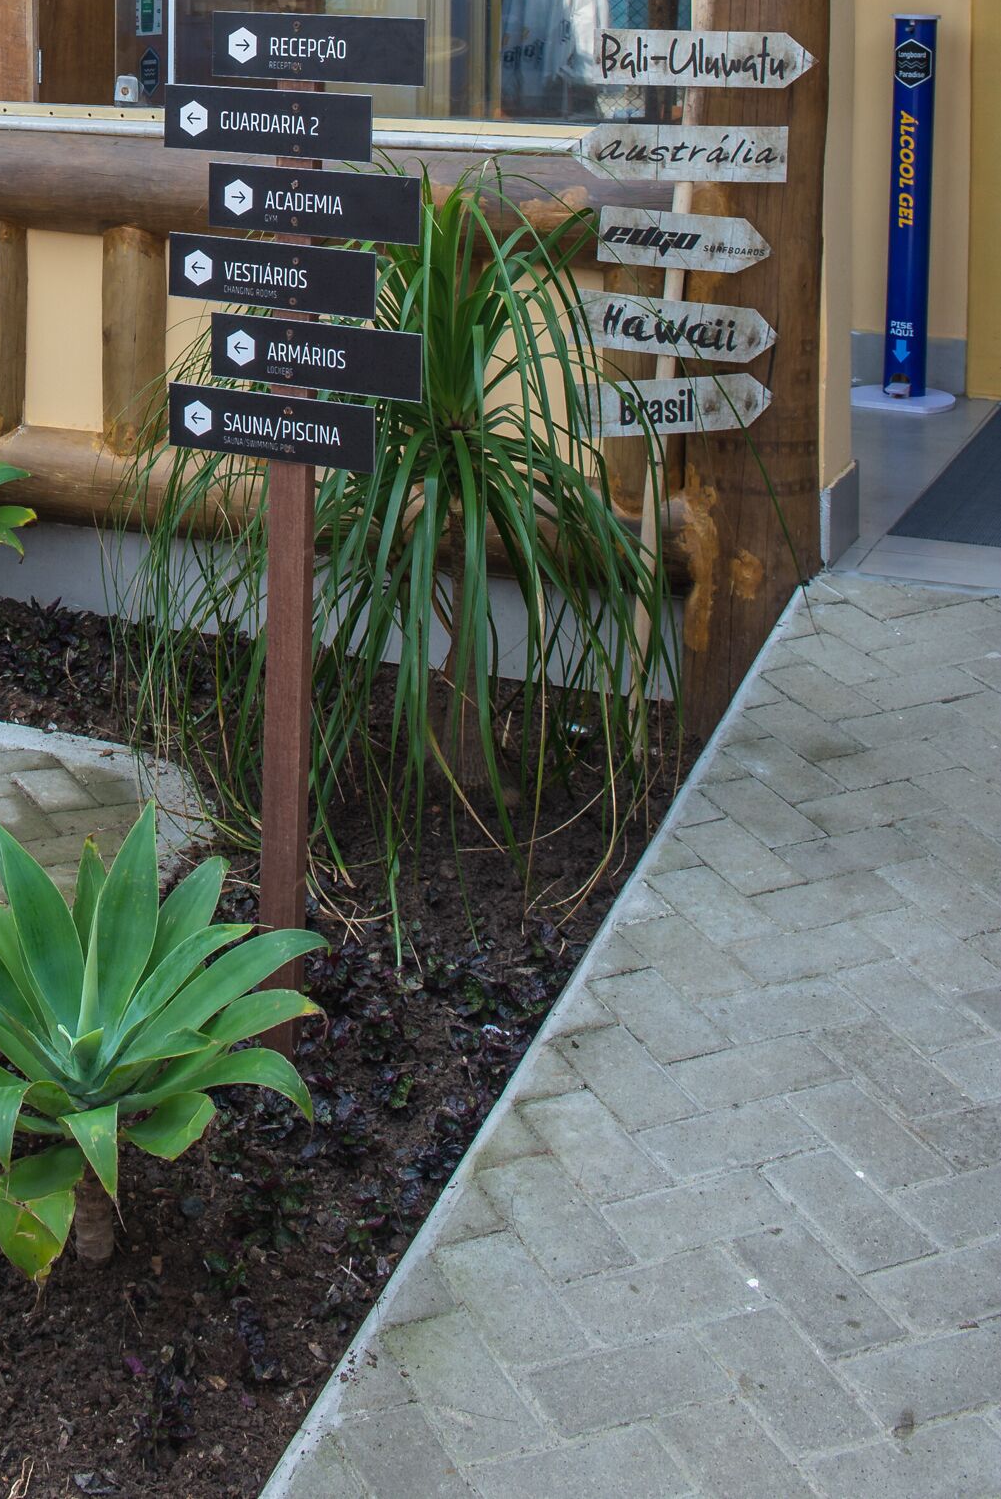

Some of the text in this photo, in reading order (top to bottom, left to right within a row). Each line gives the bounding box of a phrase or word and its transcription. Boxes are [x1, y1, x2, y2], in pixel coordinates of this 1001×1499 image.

[269, 36, 347, 63] RECEPÇÃO
[601, 33, 785, 84] Bali-Uluwatu
[898, 51, 927, 59] Longboard
[269, 61, 302, 70] RECEPTN
[898, 70, 926, 78] Paradise
[220, 111, 319, 136] GUARDARIA 2
[598, 134, 778, 164] austrália
[898, 110, 919, 228] ÁLCOOL GEL
[264, 190, 343, 215] ACADEMIA
[264, 214, 278, 222] GYM
[703, 245, 766, 256] SURFBOARDS
[223, 261, 308, 289] VESTIÁRIOS
[223, 284, 278, 299] CHANGING ROOMS
[602, 303, 738, 352] Hawaii
[890, 320, 914, 329] PISE
[890, 328, 914, 337] AQUI
[267, 342, 346, 369] ARMÁRIOS
[266, 365, 294, 377] LOCKERS
[620, 388, 694, 426] Brasil
[223, 412, 341, 446] SAUNA/PISCINA
[280, 443, 296, 454] POL
